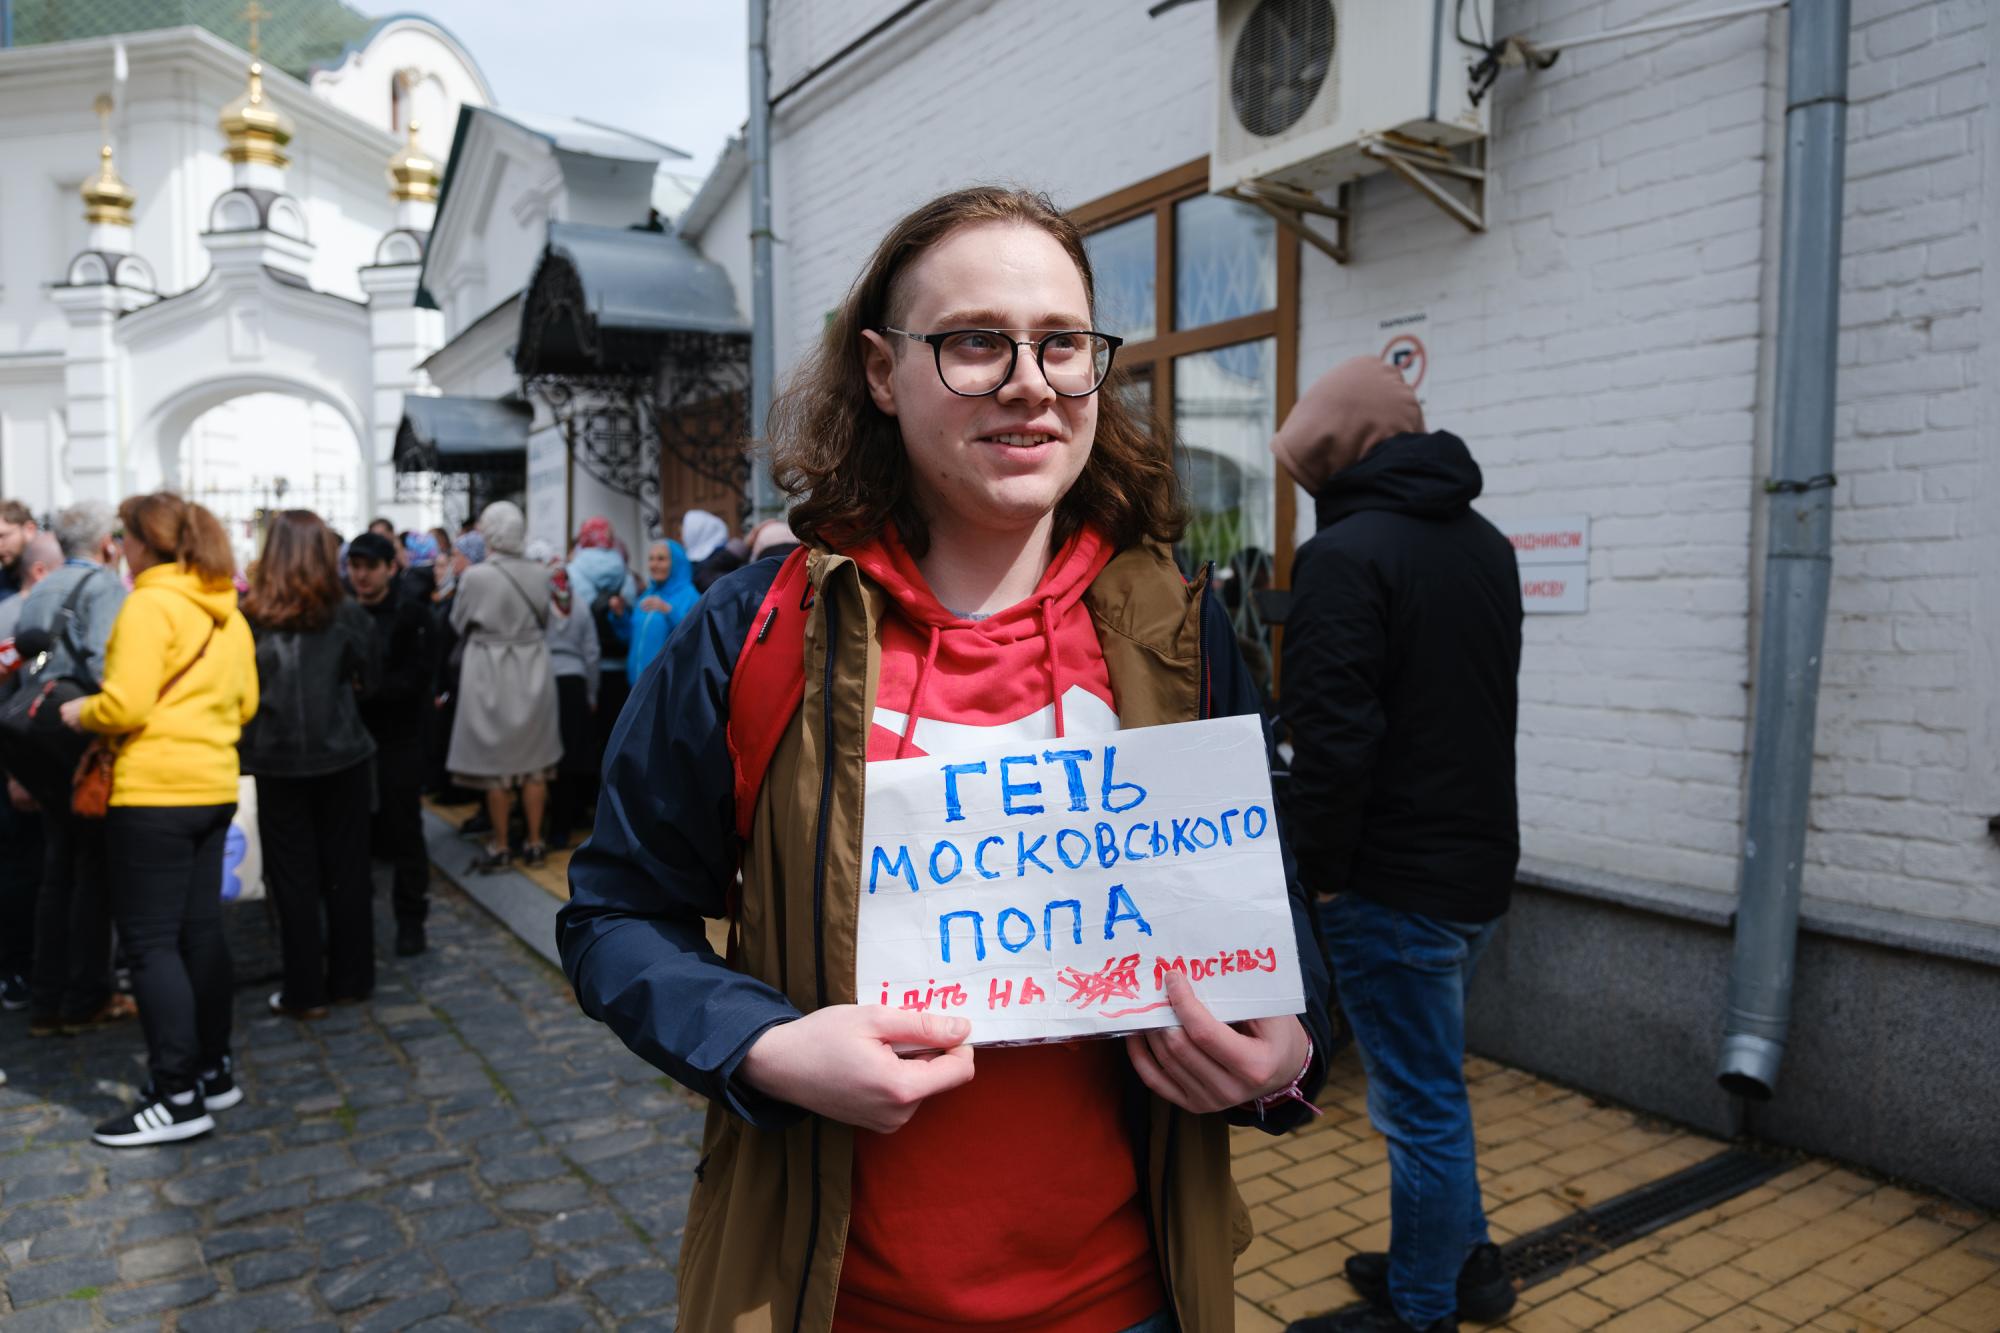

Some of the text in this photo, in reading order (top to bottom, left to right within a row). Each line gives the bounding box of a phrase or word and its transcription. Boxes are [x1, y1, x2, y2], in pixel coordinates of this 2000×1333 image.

[940, 745, 1147, 822] ГЕТЬ
[868, 805, 1268, 895] МОСКОВСЬКОГО
[939, 884, 1152, 963] ПОПА
